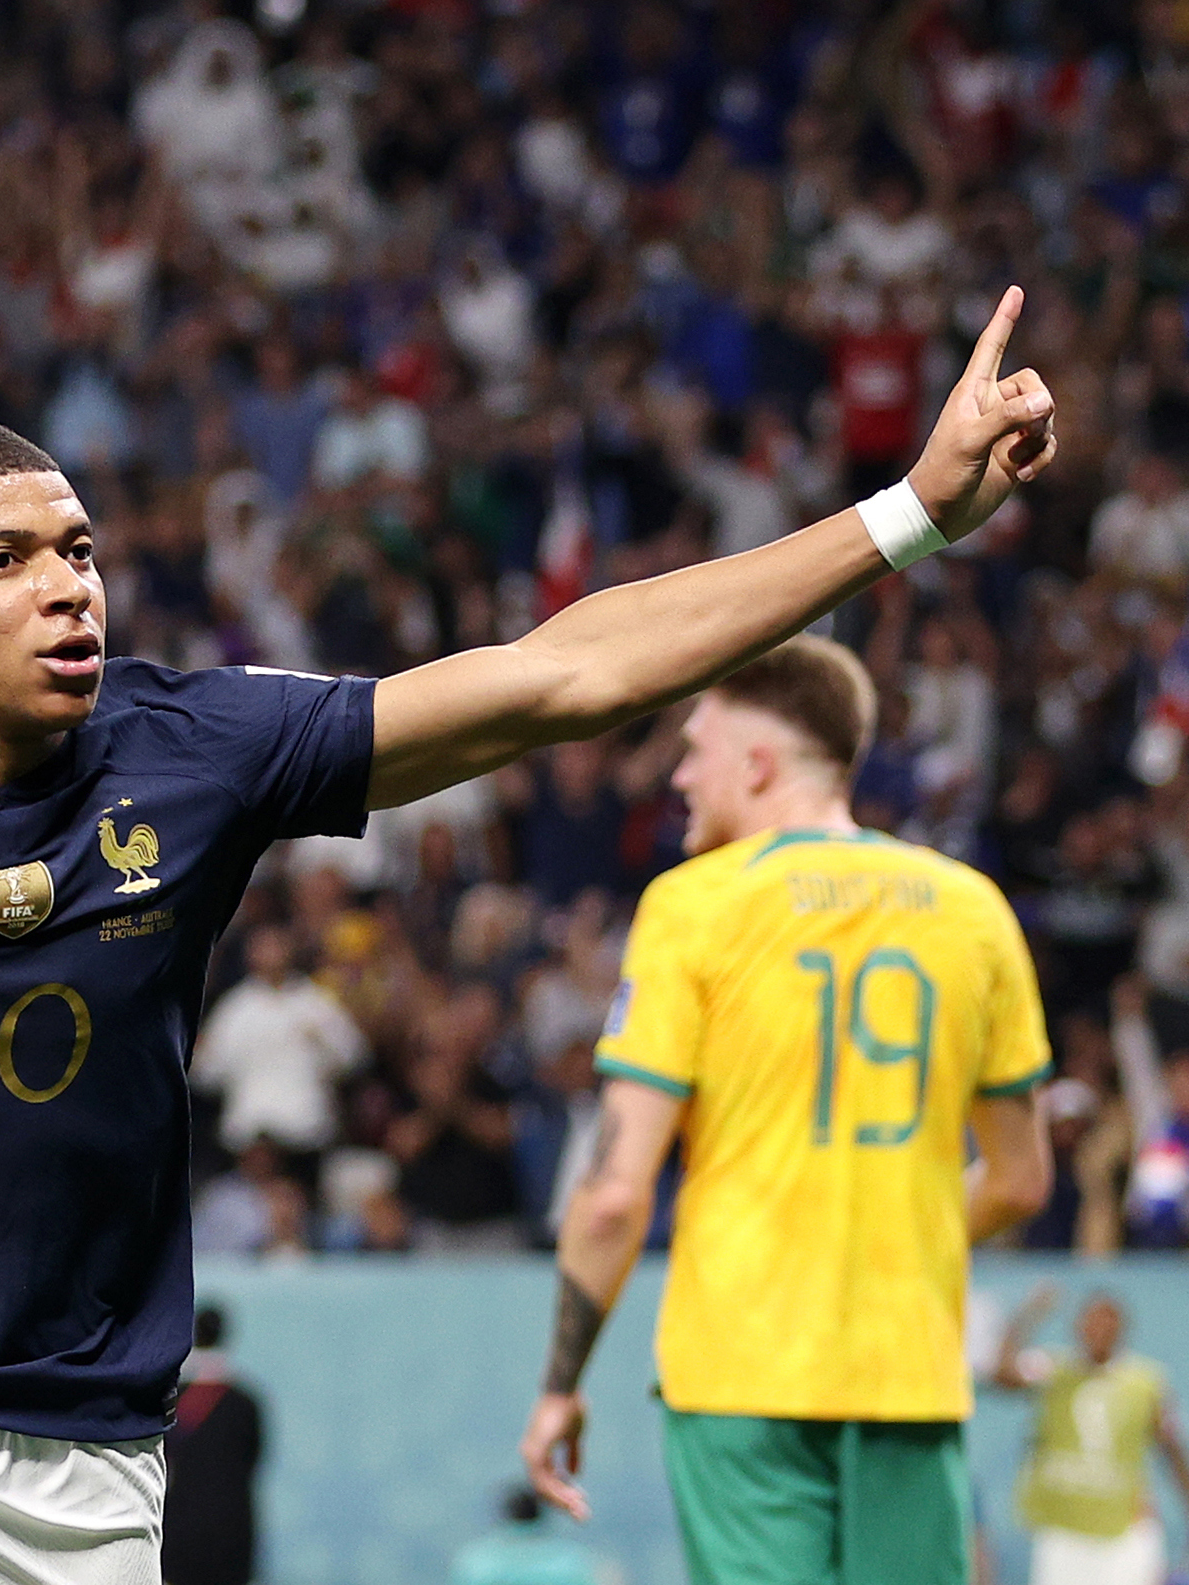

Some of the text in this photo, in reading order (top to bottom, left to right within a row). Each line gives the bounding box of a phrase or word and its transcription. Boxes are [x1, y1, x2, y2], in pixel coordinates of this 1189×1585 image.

[2, 905, 32, 918] FIFA
[98, 930, 112, 942] 22
[796, 946, 938, 1146] 19
